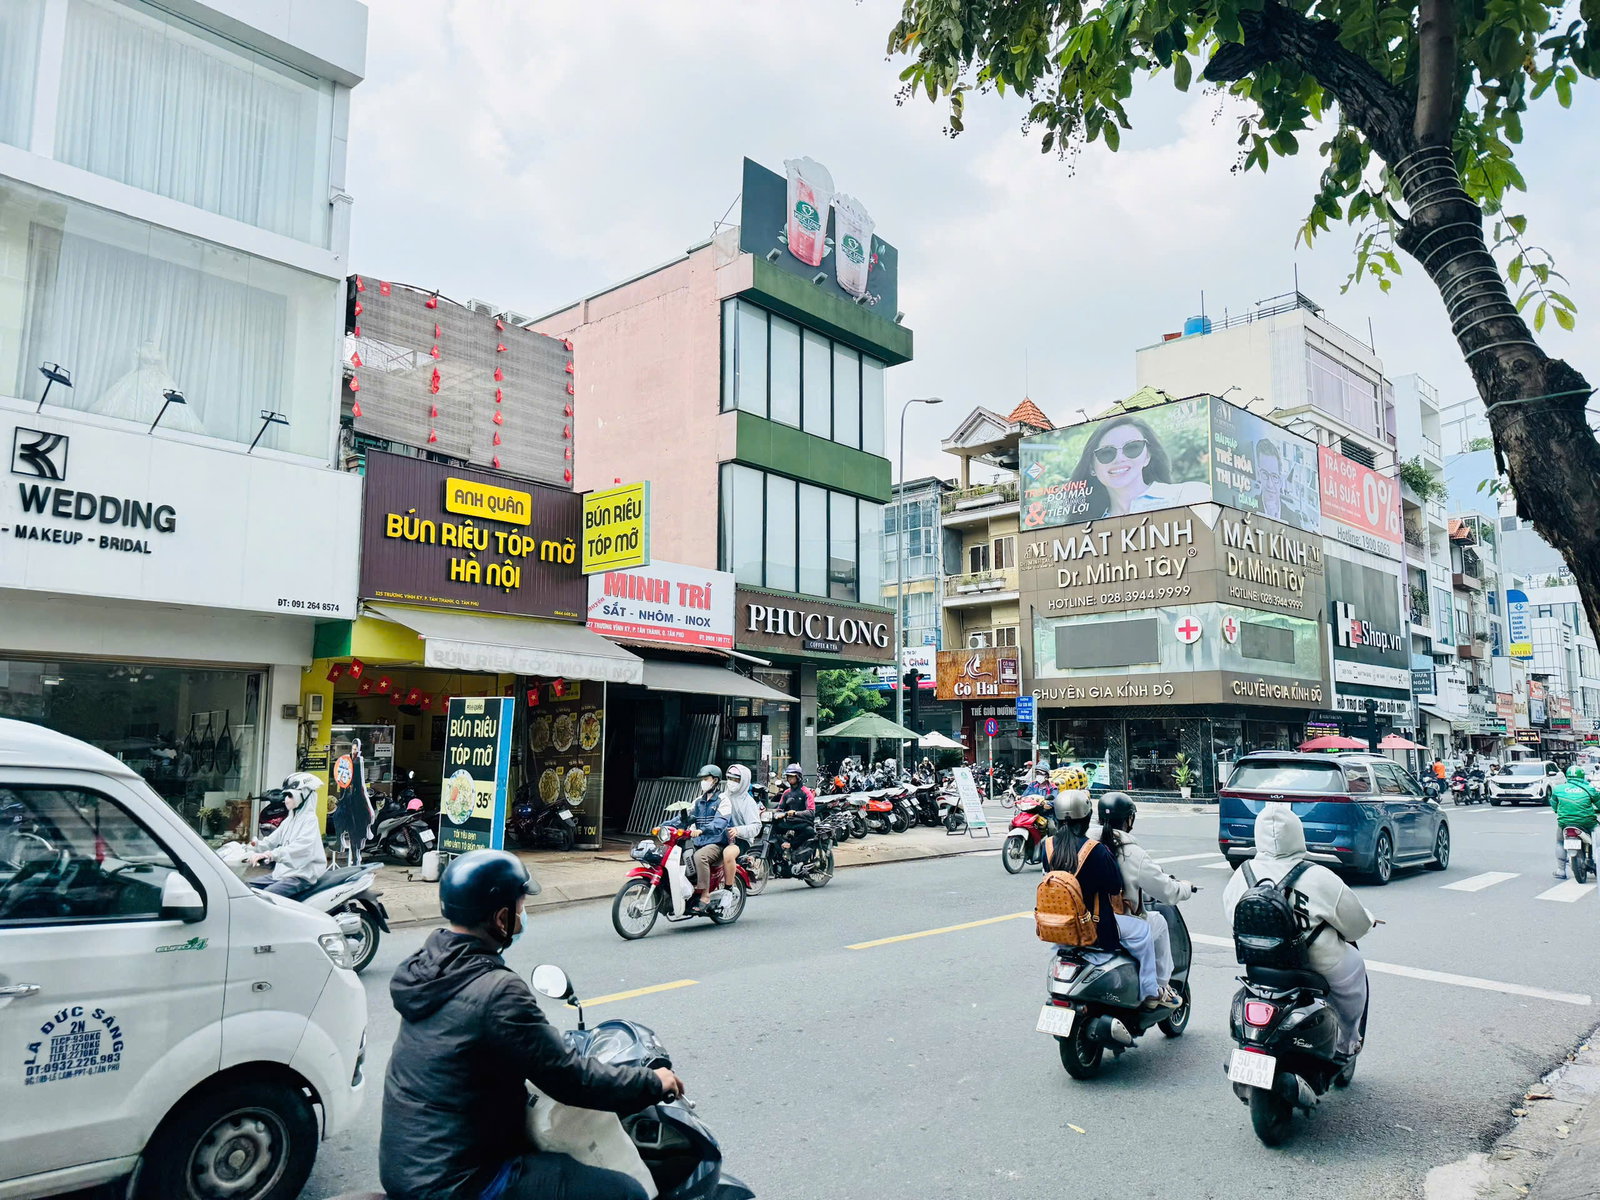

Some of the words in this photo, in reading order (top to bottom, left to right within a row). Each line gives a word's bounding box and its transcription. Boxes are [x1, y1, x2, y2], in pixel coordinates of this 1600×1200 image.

[1215, 447, 1233, 466] TRẺ
[1324, 453, 1338, 473] TRẢ
[1340, 461, 1357, 480] GÓP
[19, 482, 176, 533] WEDDING
[454, 489, 483, 504] ANH
[488, 495, 524, 515] QUÂN
[585, 506, 611, 530] BÚN
[614, 498, 642, 523] RIÊU
[1363, 473, 1399, 535] 0%
[15, 525, 83, 545] MAKEUP
[99, 535, 152, 554] BRIDAL
[387, 509, 436, 544] BÚN
[442, 519, 489, 551] RIÊU
[495, 529, 536, 557] TÓP
[587, 533, 611, 558] TÓP
[1054, 522, 1112, 562] MẮT
[1121, 518, 1193, 552] KÍNH
[1223, 512, 1264, 554] MẮT
[1270, 529, 1307, 566] KÍNH
[1338, 526, 1361, 546] Hotline:
[451, 553, 481, 584] HÀ
[487, 560, 521, 592] NỘI
[1057, 568, 1083, 588] Dr.
[1087, 560, 1138, 584] Minh
[1144, 555, 1187, 579] Tây
[1227, 552, 1246, 579] Dr.
[1248, 557, 1280, 587] Minh
[1282, 566, 1305, 598] Tây
[604, 572, 671, 605] MINH
[677, 582, 713, 610] TRÍ
[1048, 595, 1097, 610] HOTLINE:
[1101, 585, 1191, 604] 028.3944.9999
[1229, 586, 1260, 601] HOTLINE:
[291, 600, 306, 609] 091
[307, 601, 320, 611] 264
[321, 602, 340, 612] 8574
[603, 601, 626, 616] SẮT
[639, 609, 674, 624] NHÔM
[685, 615, 711, 628] INOX
[825, 615, 890, 648] LONG
[954, 682, 972, 696] Cô
[977, 680, 998, 695] Hai
[1032, 684, 1085, 700] CHUYÊN
[1089, 687, 1113, 699] GIA
[1117, 681, 1149, 698] KÍNH
[1153, 680, 1174, 698] ĐỘ
[1233, 679, 1273, 698] CHUYÊN
[1273, 684, 1288, 699] GIA
[1291, 682, 1310, 700] KÍNH
[1311, 684, 1322, 704] ĐỘ
[450, 715, 471, 738] BÚN
[474, 715, 497, 738] RIÊU
[450, 743, 470, 765] TÓP
[70, 1020, 85, 1034] 2N
